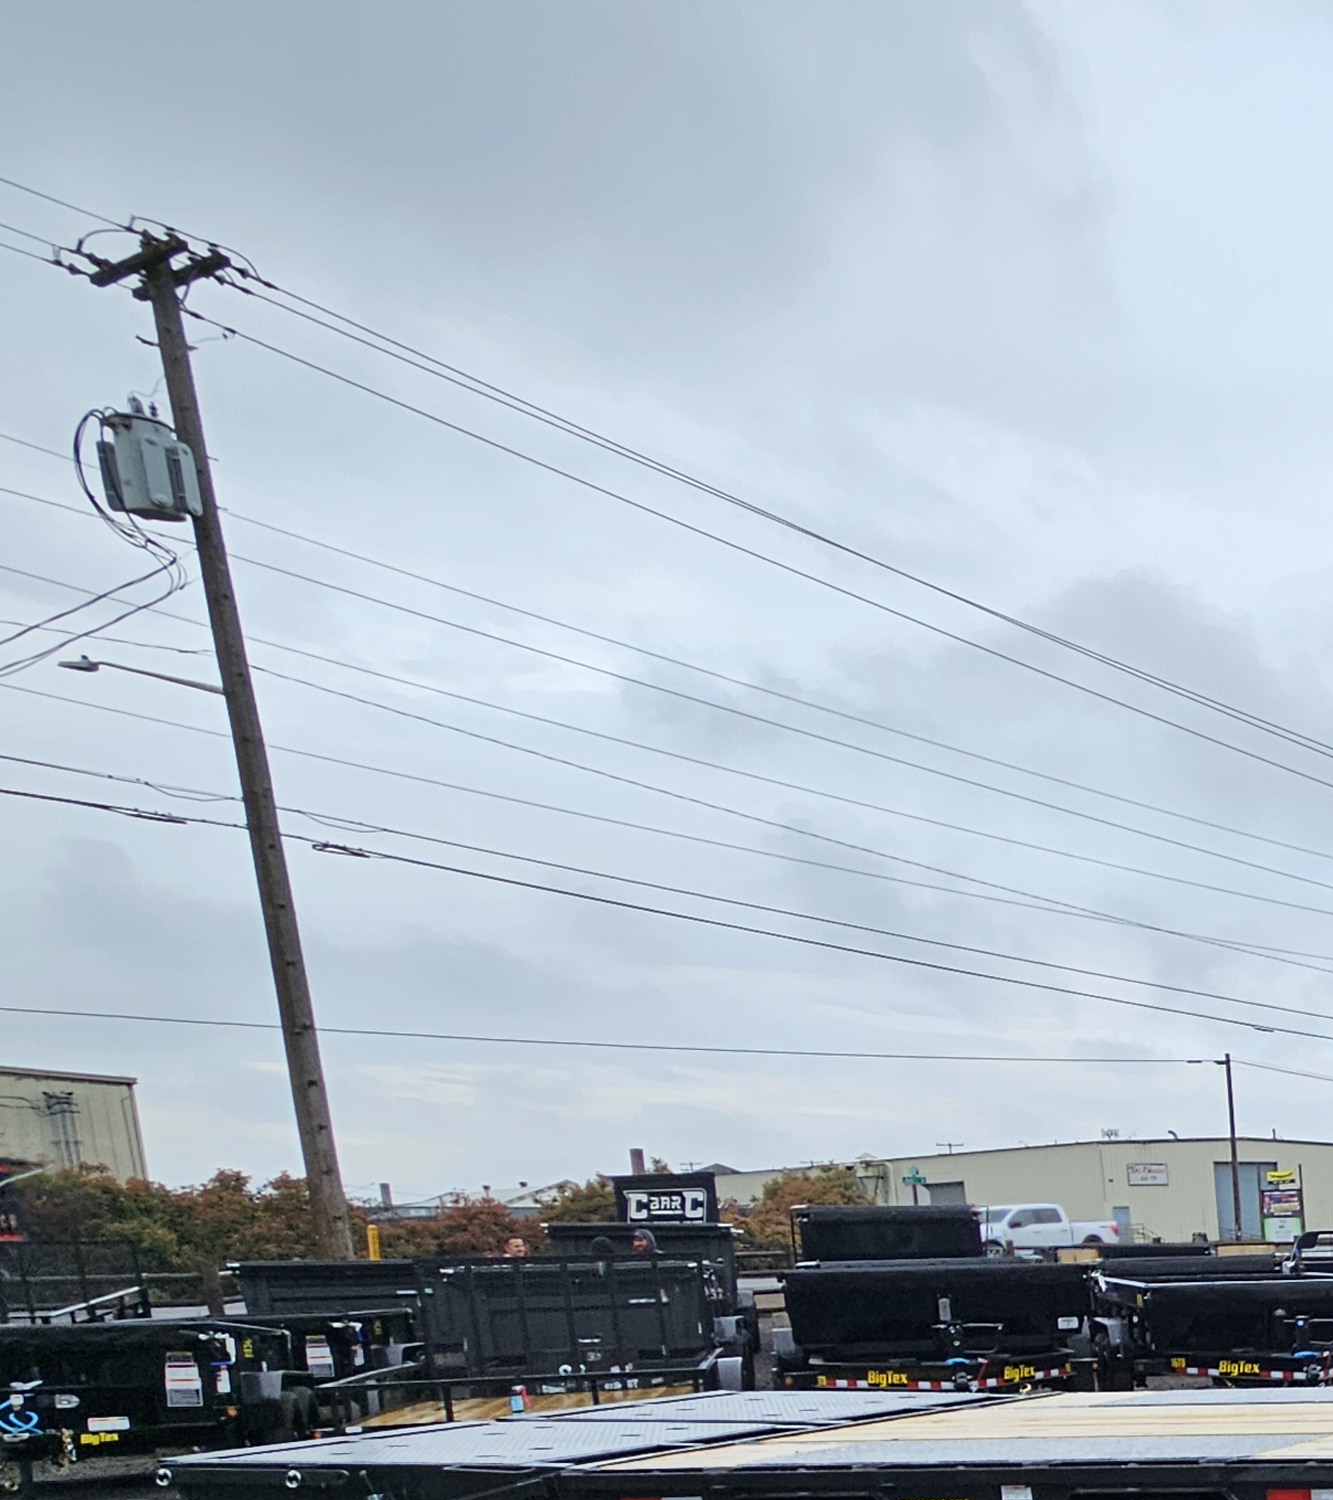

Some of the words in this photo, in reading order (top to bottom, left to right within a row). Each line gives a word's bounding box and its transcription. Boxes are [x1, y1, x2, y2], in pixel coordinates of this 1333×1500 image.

[628, 1193, 648, 1219] C
[682, 1191, 704, 1218] C
[1004, 1365, 1036, 1382] BigTex
[1219, 1360, 1260, 1377] BigTex
[867, 1370, 908, 1387] BigTex
[80, 1432, 119, 1446] BigTex
